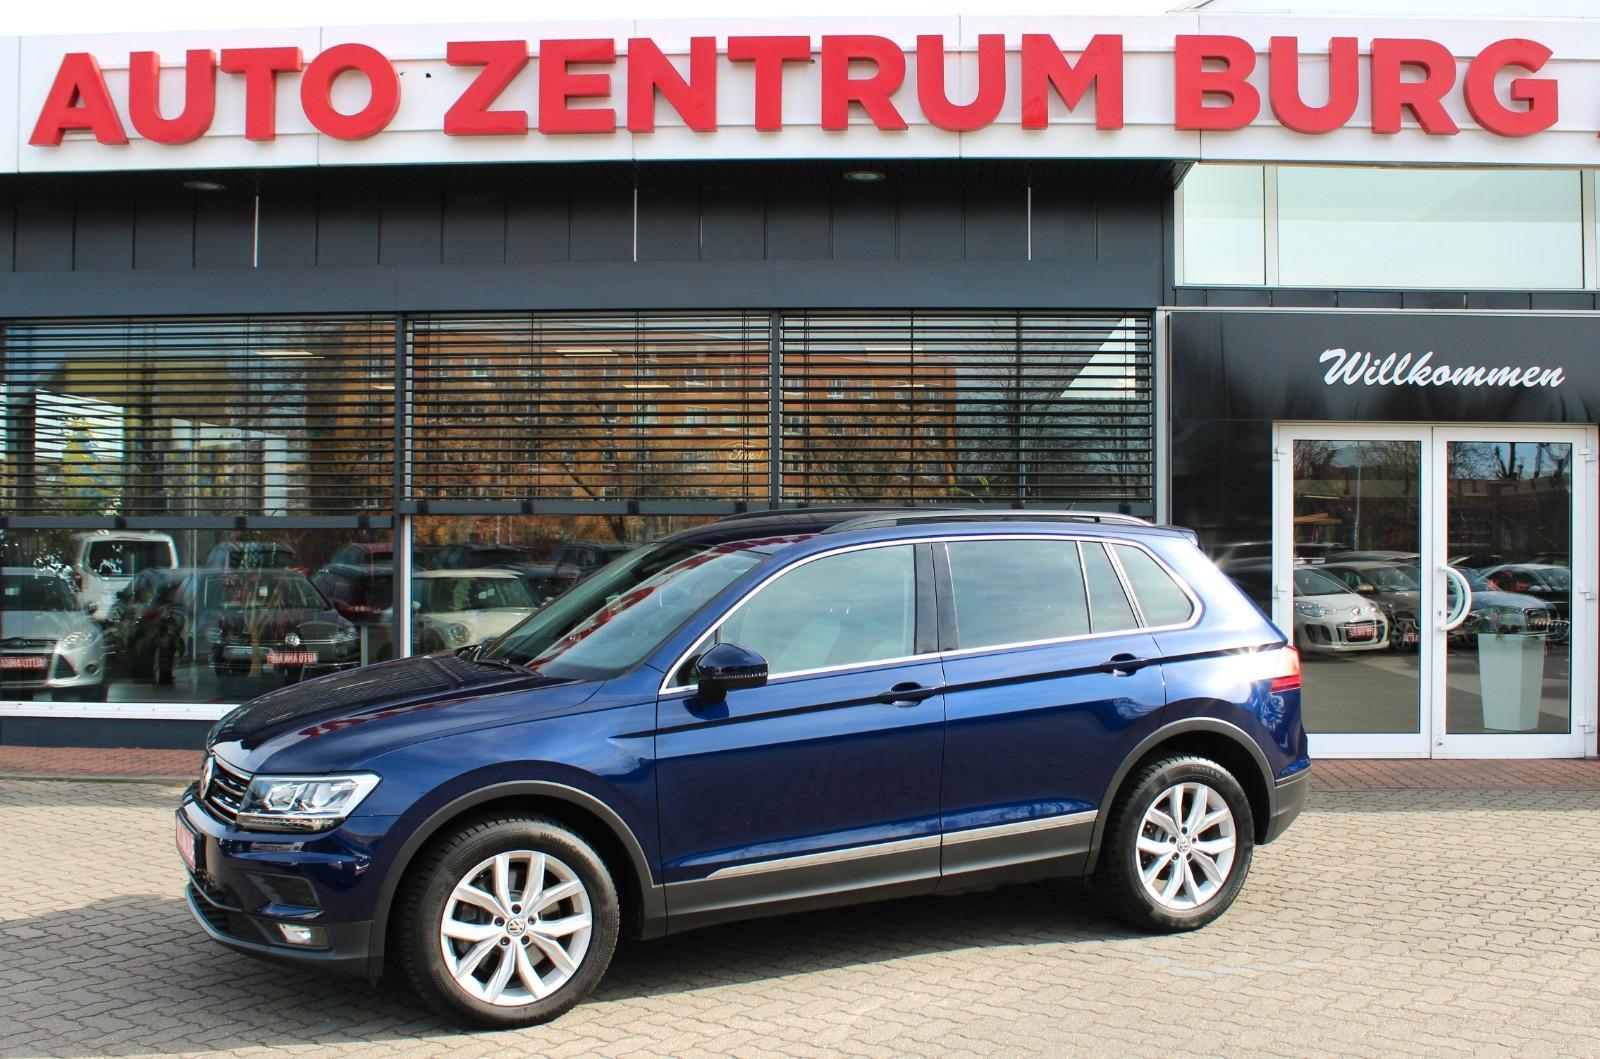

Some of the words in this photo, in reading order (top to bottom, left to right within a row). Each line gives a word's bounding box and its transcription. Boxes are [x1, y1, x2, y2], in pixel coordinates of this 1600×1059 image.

[28, 43, 400, 147] AUTO
[444, 34, 1124, 136] ZENTRUM
[1175, 36, 1559, 138] BURG
[1319, 348, 1566, 388] Willkommen
